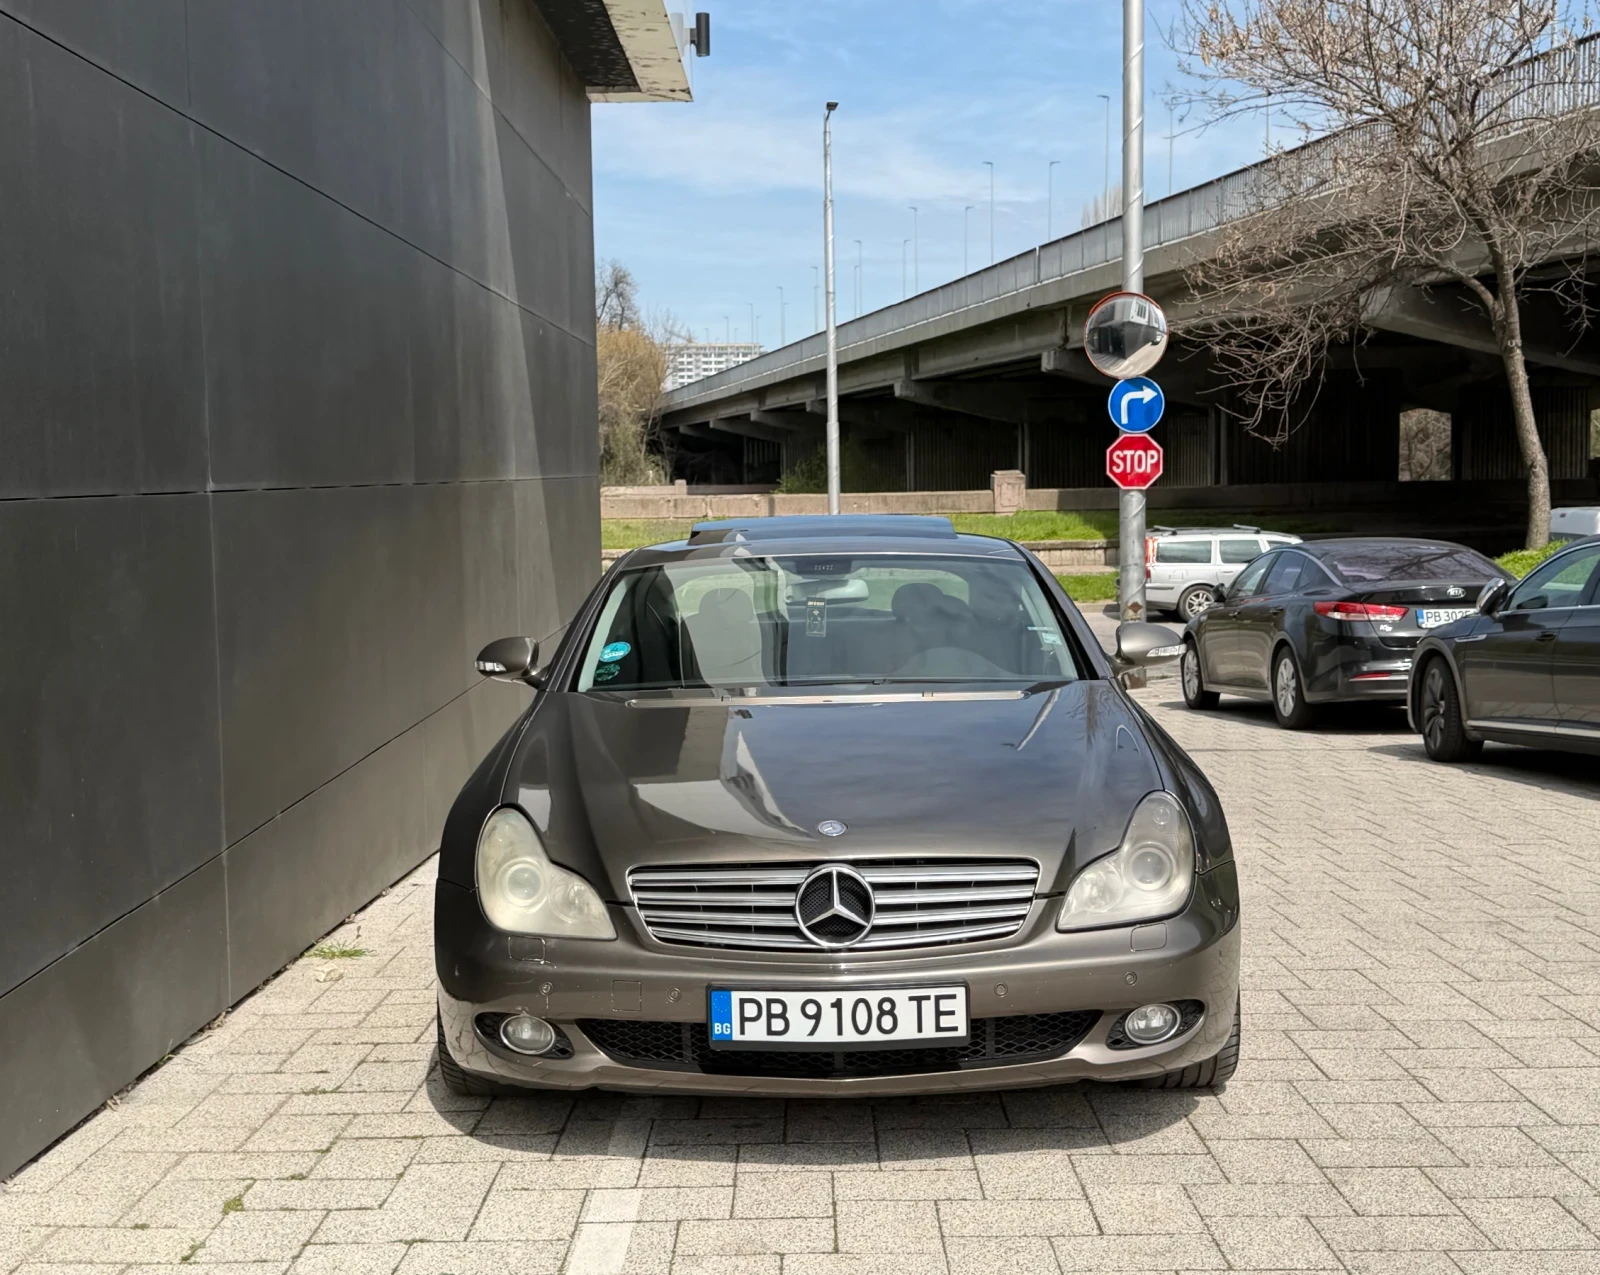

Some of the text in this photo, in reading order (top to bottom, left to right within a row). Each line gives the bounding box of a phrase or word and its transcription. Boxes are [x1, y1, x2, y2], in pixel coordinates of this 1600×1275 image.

[1112, 449, 1158, 473] STOP
[1425, 611, 1441, 622] PB
[738, 993, 959, 1036] PB 9108 TE
[714, 1022, 731, 1035] BG
